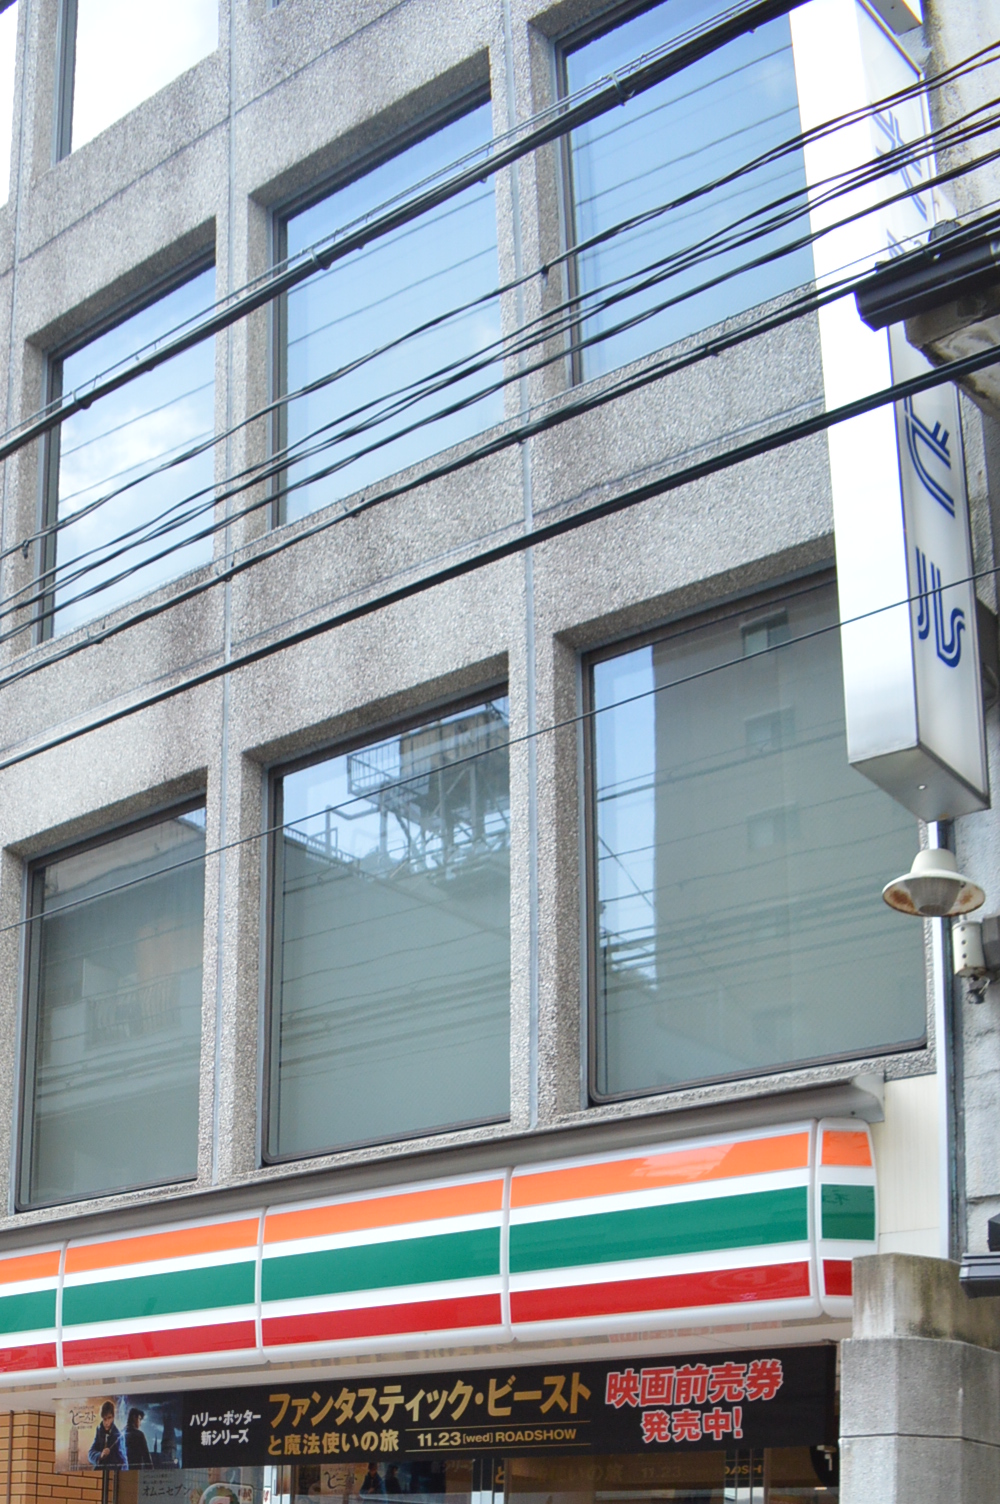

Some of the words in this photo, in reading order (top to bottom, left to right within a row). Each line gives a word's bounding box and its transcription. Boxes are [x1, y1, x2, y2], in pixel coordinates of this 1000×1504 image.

[605, 1358, 784, 1409] 映画前売券
[268, 1372, 592, 1429] ファンタスティック・ビースト
[189, 1409, 262, 1428] ハリー・ポッター
[641, 1406, 744, 1443] 発売中!
[200, 1428, 250, 1446] 新シリーズ
[267, 1429, 400, 1456] と魔法使いの旅
[495, 1428, 578, 1443] ROADSHOW
[142, 1484, 192, 1497] オムニセブン
